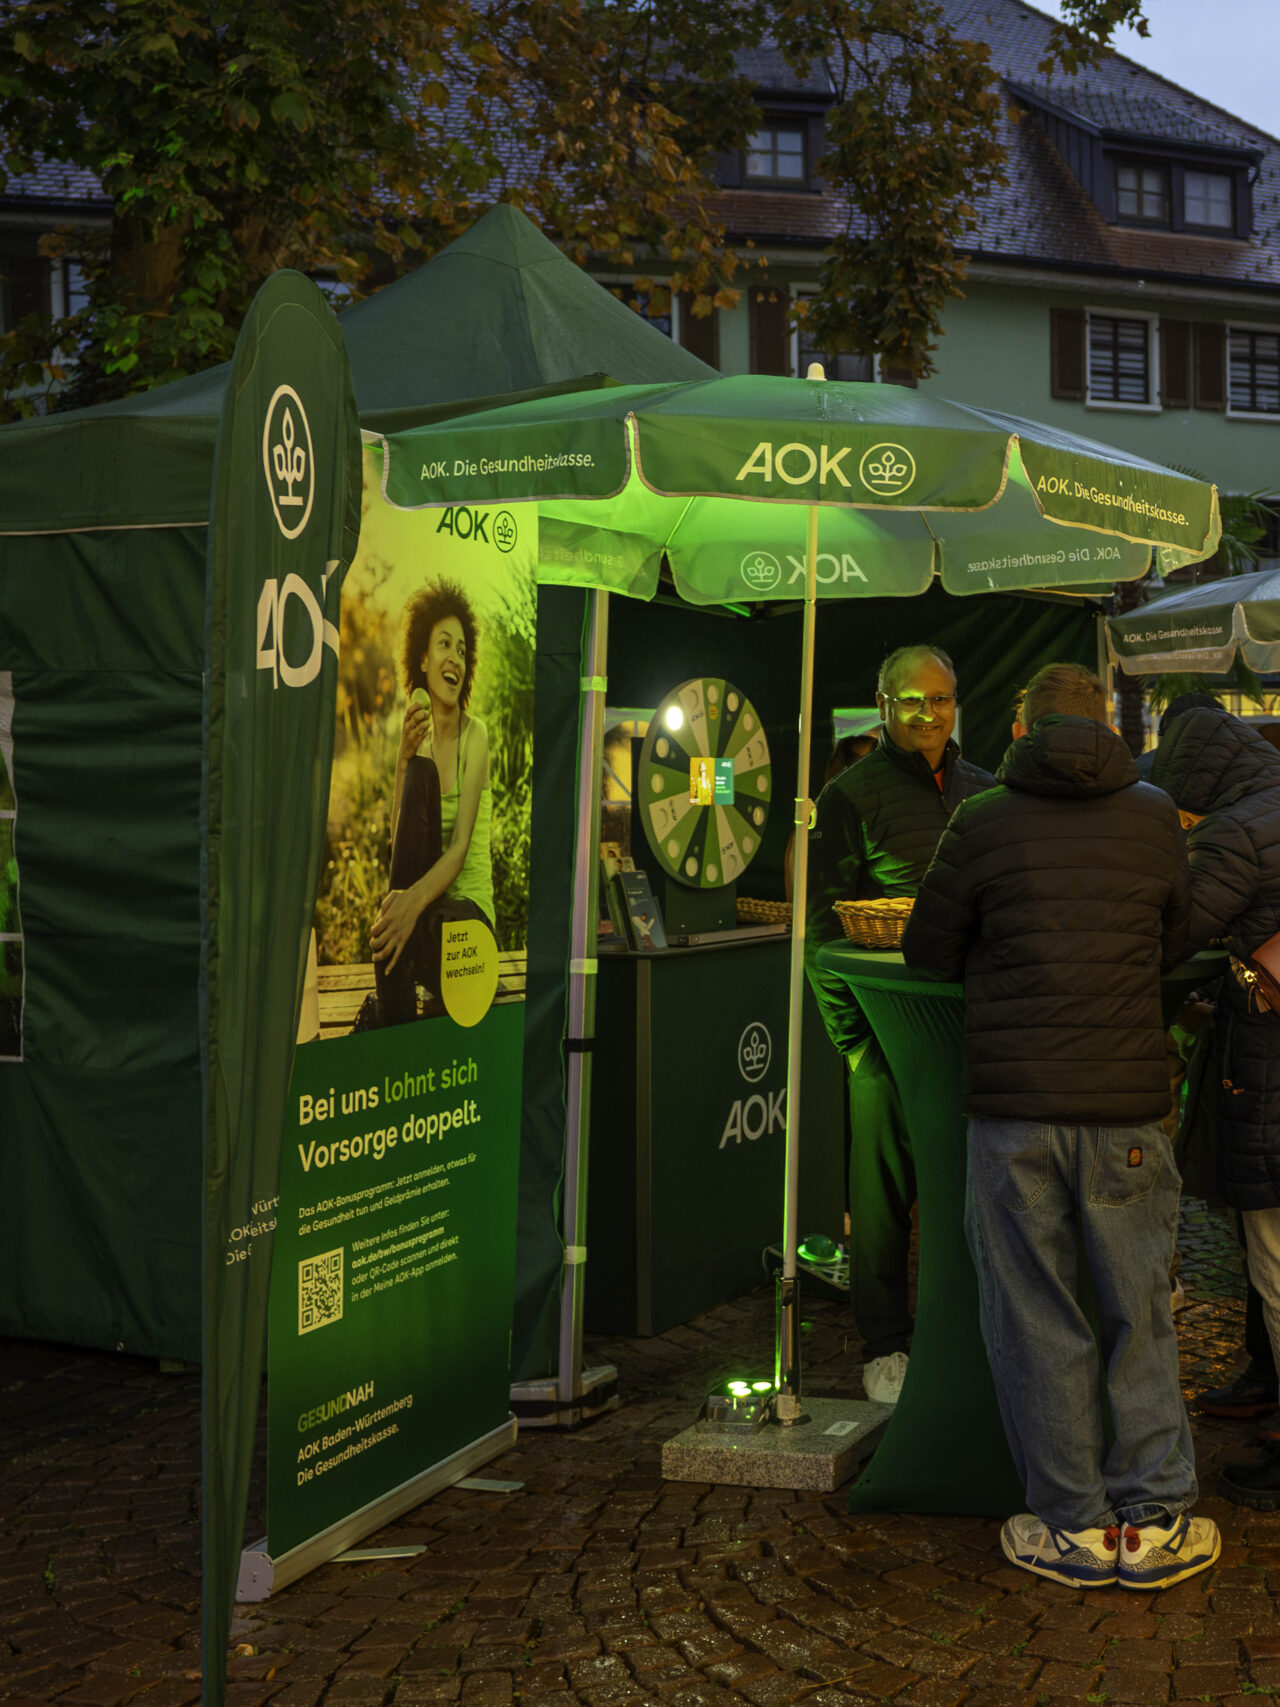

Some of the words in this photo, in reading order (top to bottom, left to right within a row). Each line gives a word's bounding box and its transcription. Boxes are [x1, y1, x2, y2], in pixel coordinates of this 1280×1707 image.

[420, 461, 449, 481] AOK.
[453, 460, 477, 477] Die
[735, 442, 852, 487] AOK
[1037, 475, 1073, 496] AOK.
[1074, 481, 1090, 500] Die
[1090, 486, 1190, 526] Gesundheitskasse.
[436, 507, 489, 543] AOK
[1146, 631, 1157, 642] Die
[446, 951, 460, 961] zur
[462, 946, 478, 959] AOK
[447, 931, 468, 943] Jetzt
[446, 962, 485, 979] wechseln!
[300, 1087, 335, 1126] Bei
[341, 1086, 379, 1115] uns
[385, 1068, 436, 1104] lohnt
[441, 1057, 478, 1089] sich
[298, 1126, 398, 1172] Vorsorge
[402, 1100, 481, 1144] doppelt.
[719, 1087, 787, 1150] AOK
[299, 1206, 315, 1219] Das
[316, 1181, 395, 1213] AOK-Bonusprogramm:
[396, 1174, 413, 1187] Jetzt
[447, 1157, 467, 1170] etwas
[468, 1152, 477, 1163] für
[299, 1223, 311, 1236] die
[313, 1209, 355, 1231] Gesundheit
[356, 1206, 369, 1217] tun
[370, 1199, 383, 1211] und
[352, 1236, 380, 1252] Weitere
[381, 1228, 398, 1241] Infos
[399, 1221, 419, 1234] finden
[420, 1215, 429, 1226] Sie
[352, 1272, 368, 1285] oder
[369, 1260, 399, 1279] QR-Code
[400, 1249, 427, 1266] scannen
[428, 1242, 440, 1255] und
[440, 1235, 459, 1250] direkt
[352, 1291, 359, 1302] in
[360, 1287, 373, 1299] der
[374, 1279, 394, 1293] Meine
[394, 1266, 424, 1284] AOK-App
[297, 1380, 374, 1432] GESUNDNAH
[297, 1440, 320, 1463] AOK
[322, 1394, 413, 1451] Baden-Württemberg
[297, 1468, 314, 1486] Die
[315, 1423, 399, 1476] Gesundheitskasse.
